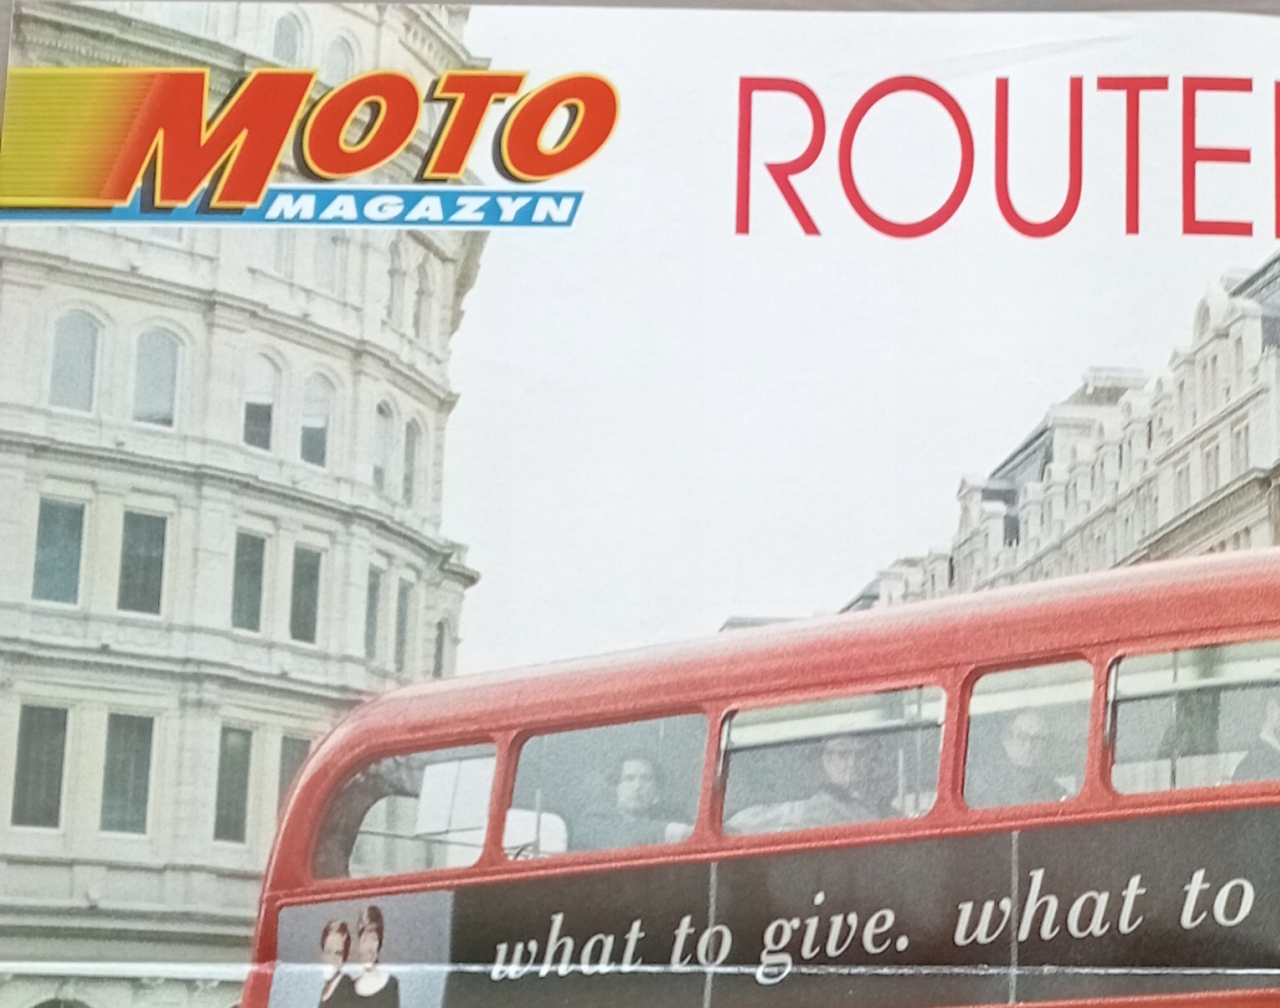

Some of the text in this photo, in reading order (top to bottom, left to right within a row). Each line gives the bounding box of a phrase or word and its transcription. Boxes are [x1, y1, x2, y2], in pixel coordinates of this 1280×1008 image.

[105, 68, 621, 209] MOTO
[265, 193, 579, 224] MAGAZYN
[489, 912, 645, 981] what
[671, 913, 733, 969] to
[754, 890, 911, 985] give.
[952, 867, 1145, 948] what
[1177, 868, 1256, 931] to
